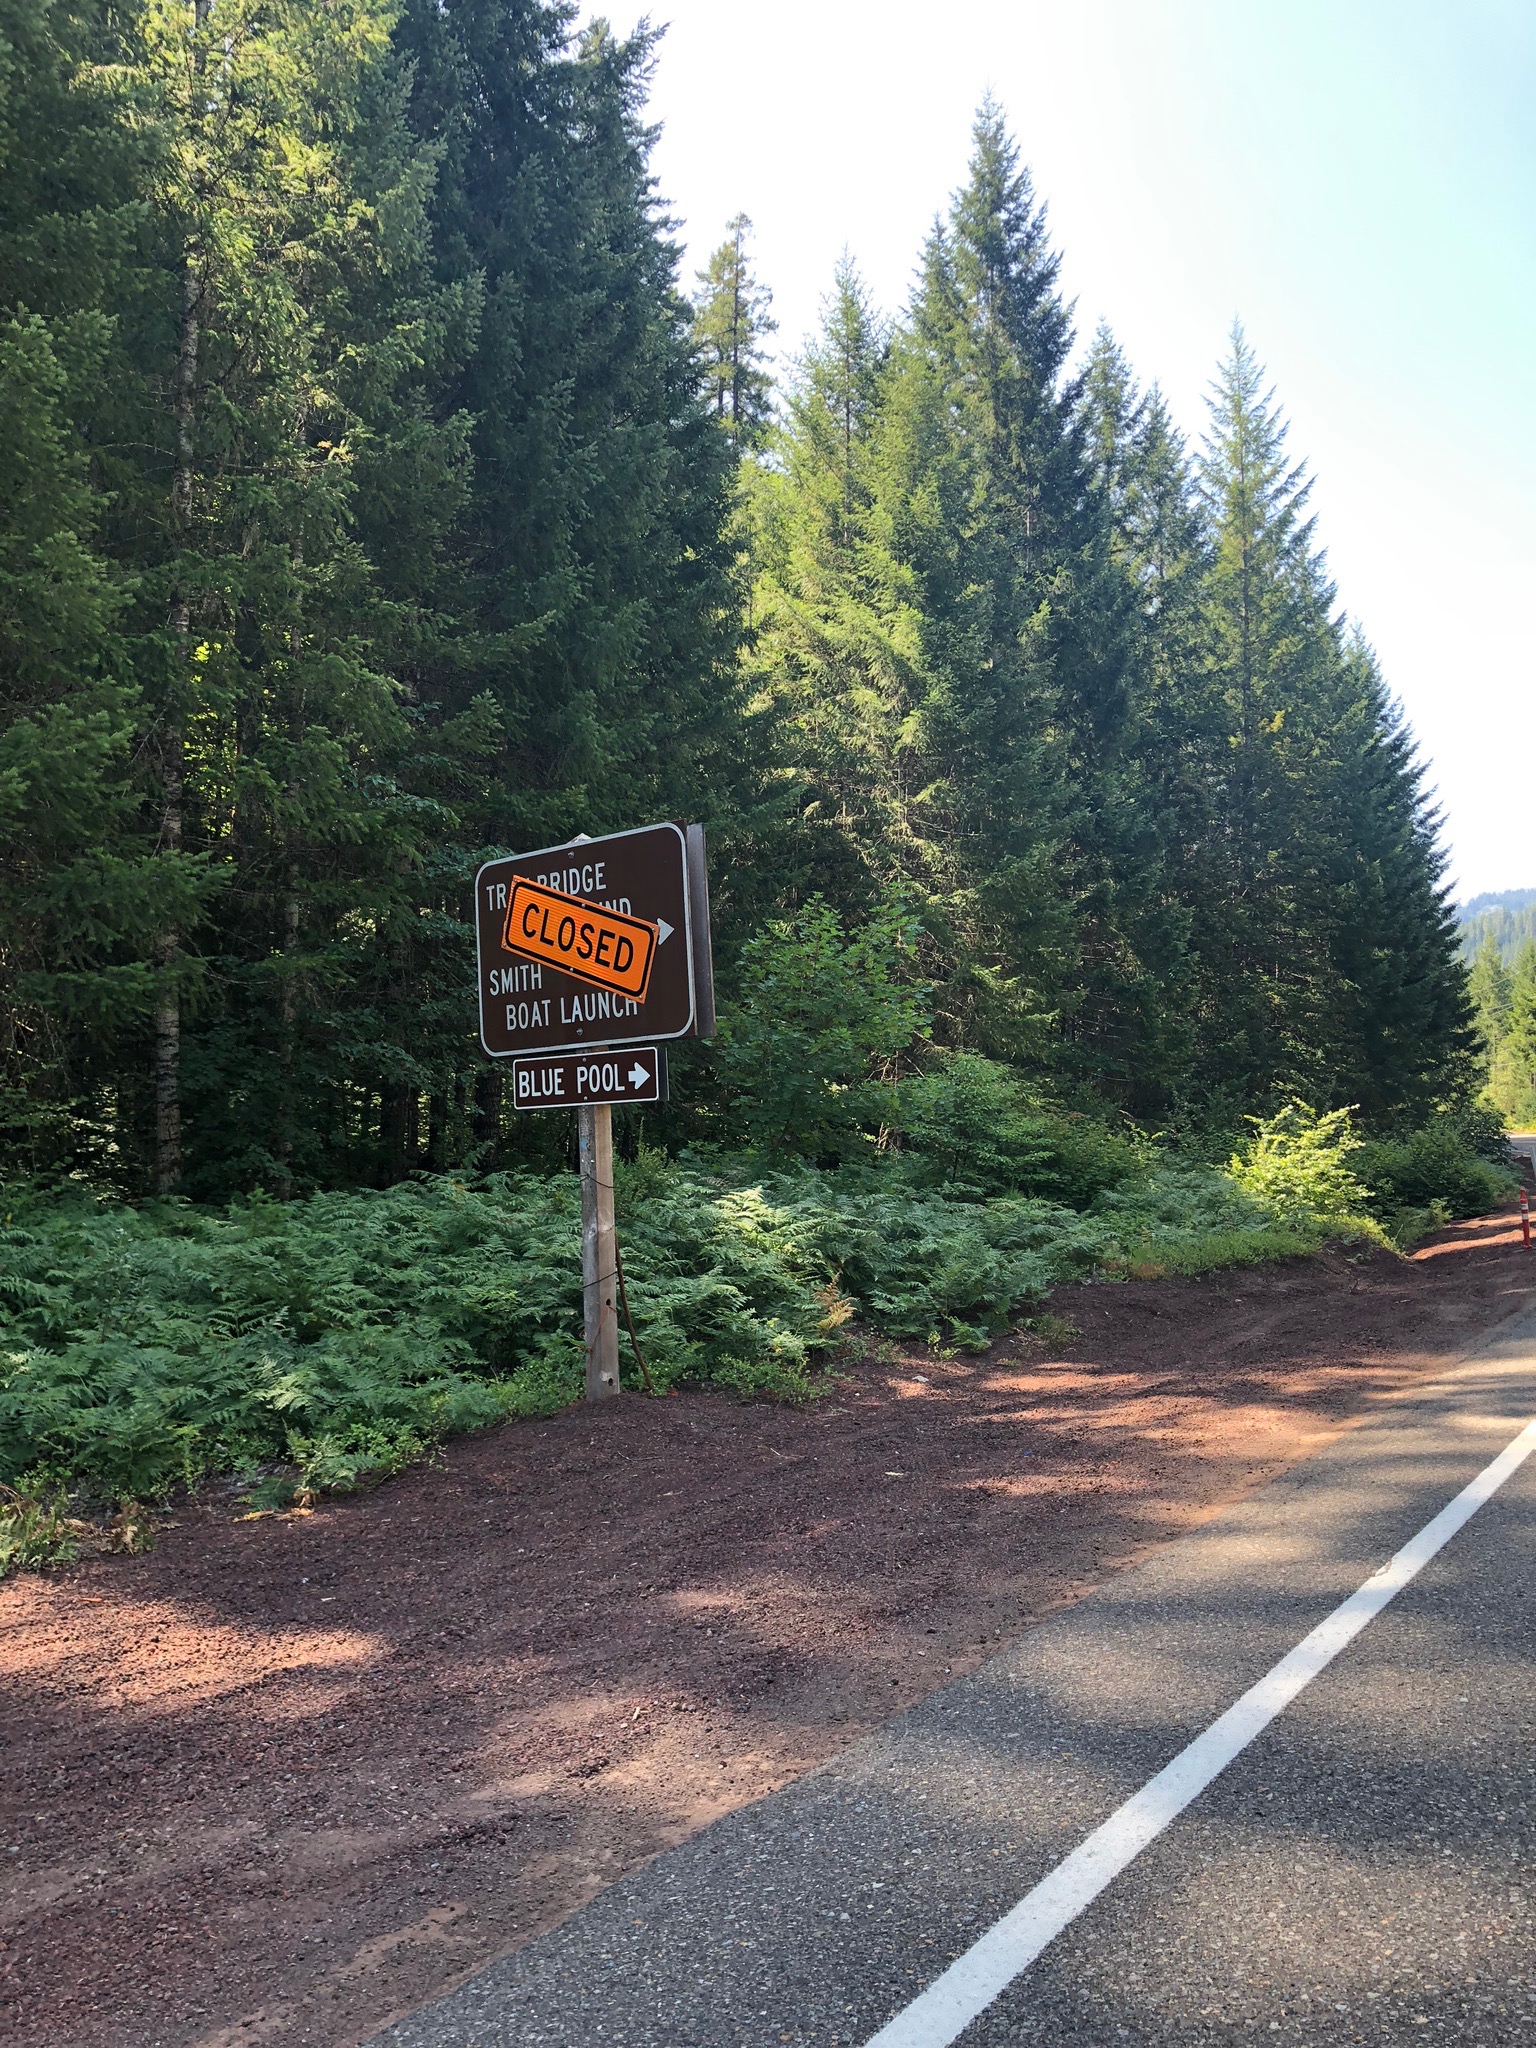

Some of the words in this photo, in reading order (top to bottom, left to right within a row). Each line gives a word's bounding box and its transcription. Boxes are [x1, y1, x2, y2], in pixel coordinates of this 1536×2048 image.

[486, 862, 606, 911] TRRIDGE
[523, 903, 634, 973] CLOSED
[489, 964, 542, 996] SMITH
[506, 999, 551, 1031] BOAT
[560, 992, 638, 1024] LAUNCH
[518, 1068, 565, 1098] BLUE
[577, 1063, 626, 1093] POOL
